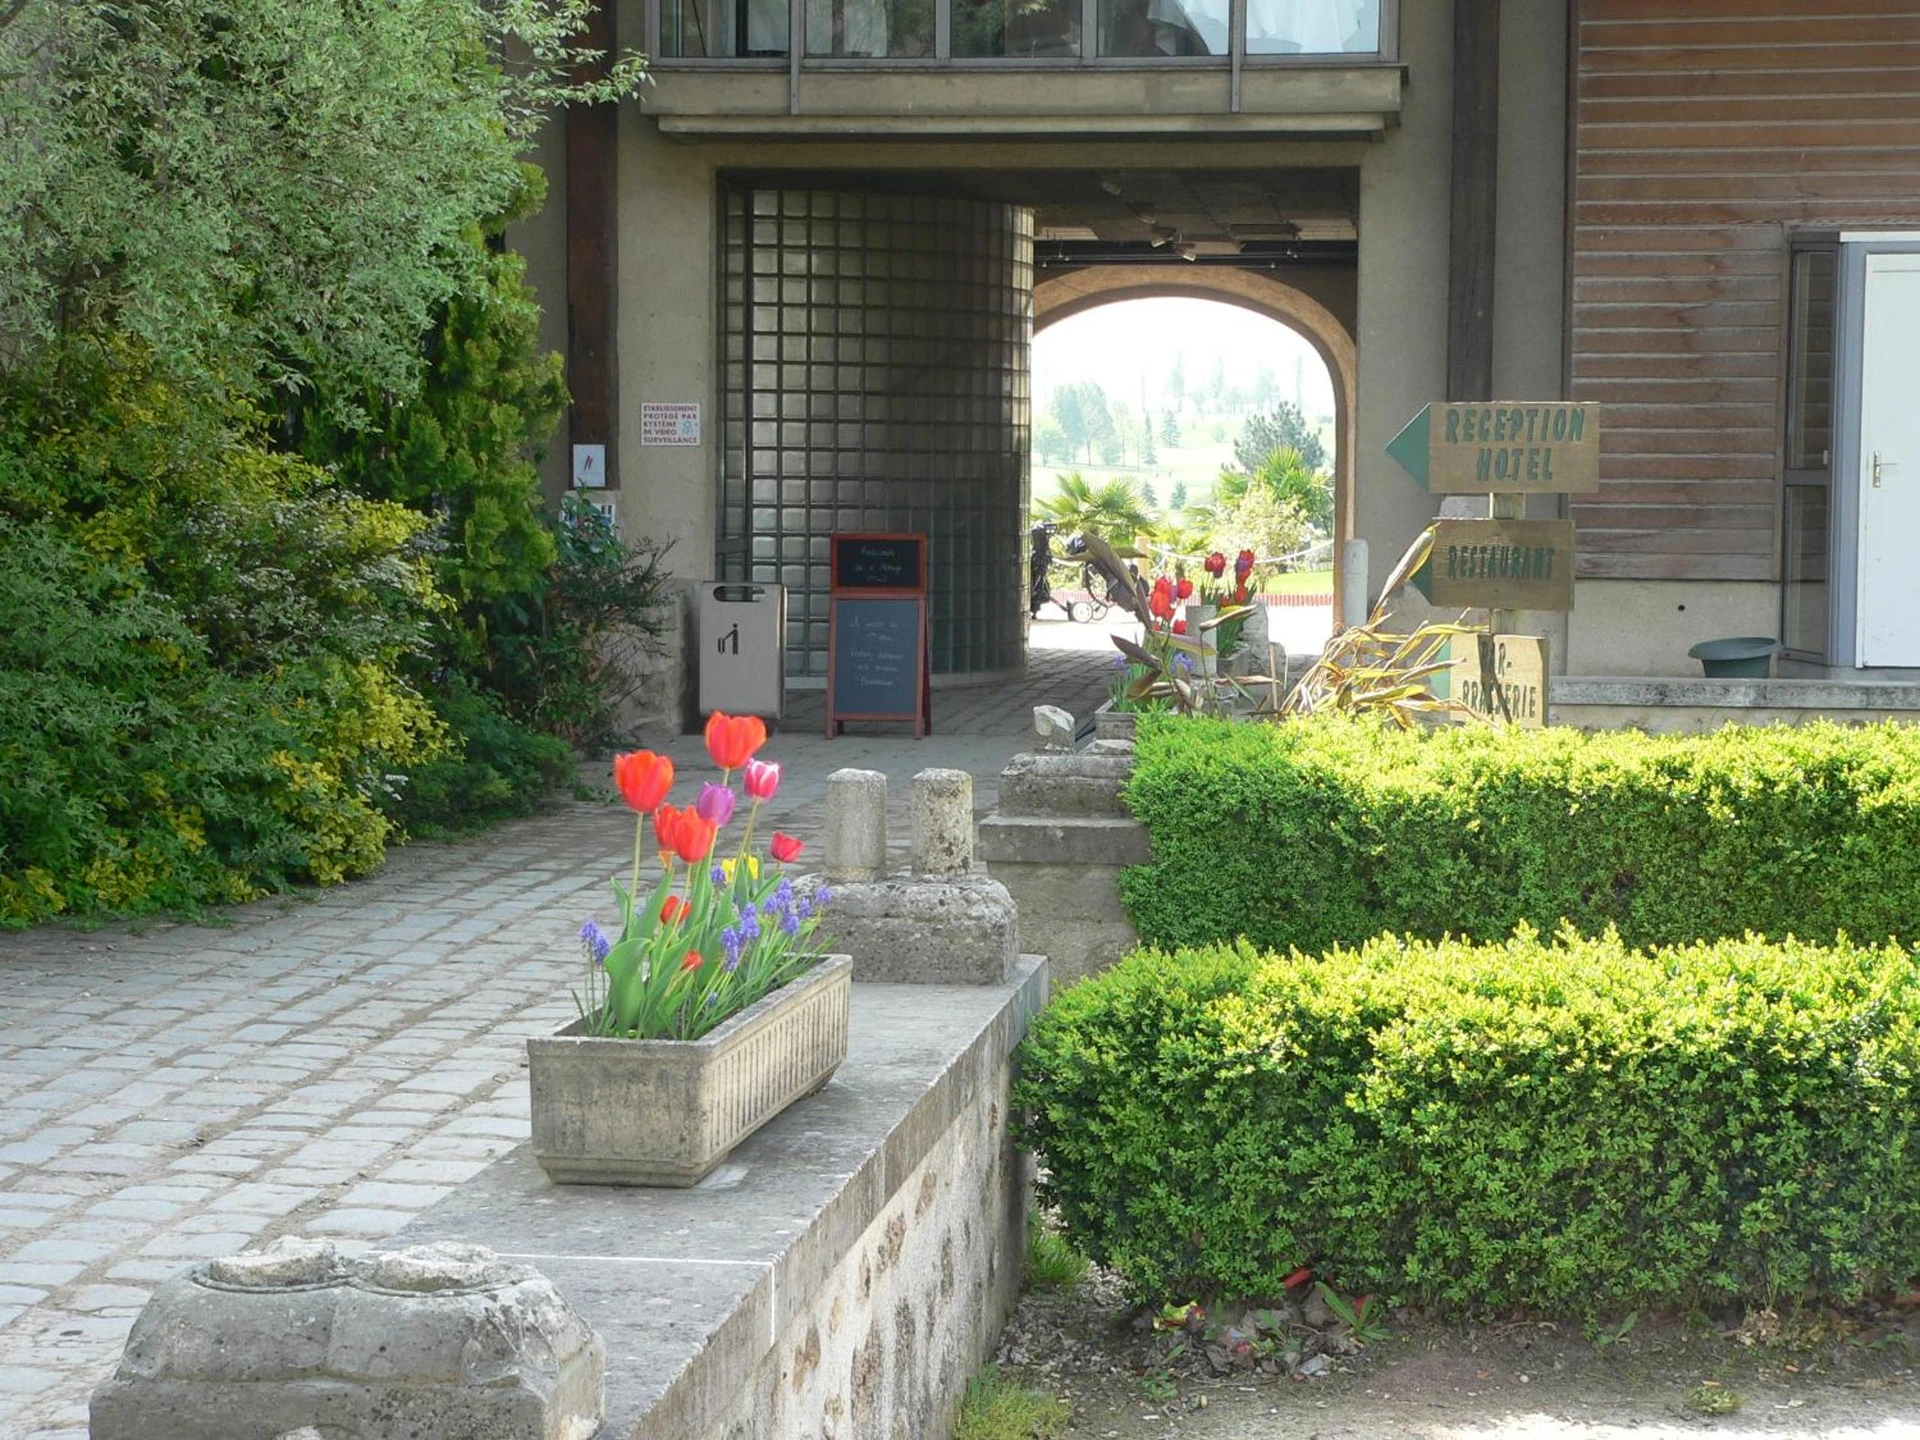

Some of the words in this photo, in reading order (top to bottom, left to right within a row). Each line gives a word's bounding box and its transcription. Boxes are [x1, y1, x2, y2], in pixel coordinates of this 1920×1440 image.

[1444, 407, 1586, 445] RECEPTION
[1475, 447, 1553, 482] HOTEL
[1446, 545, 1557, 580] RESTAURANT
